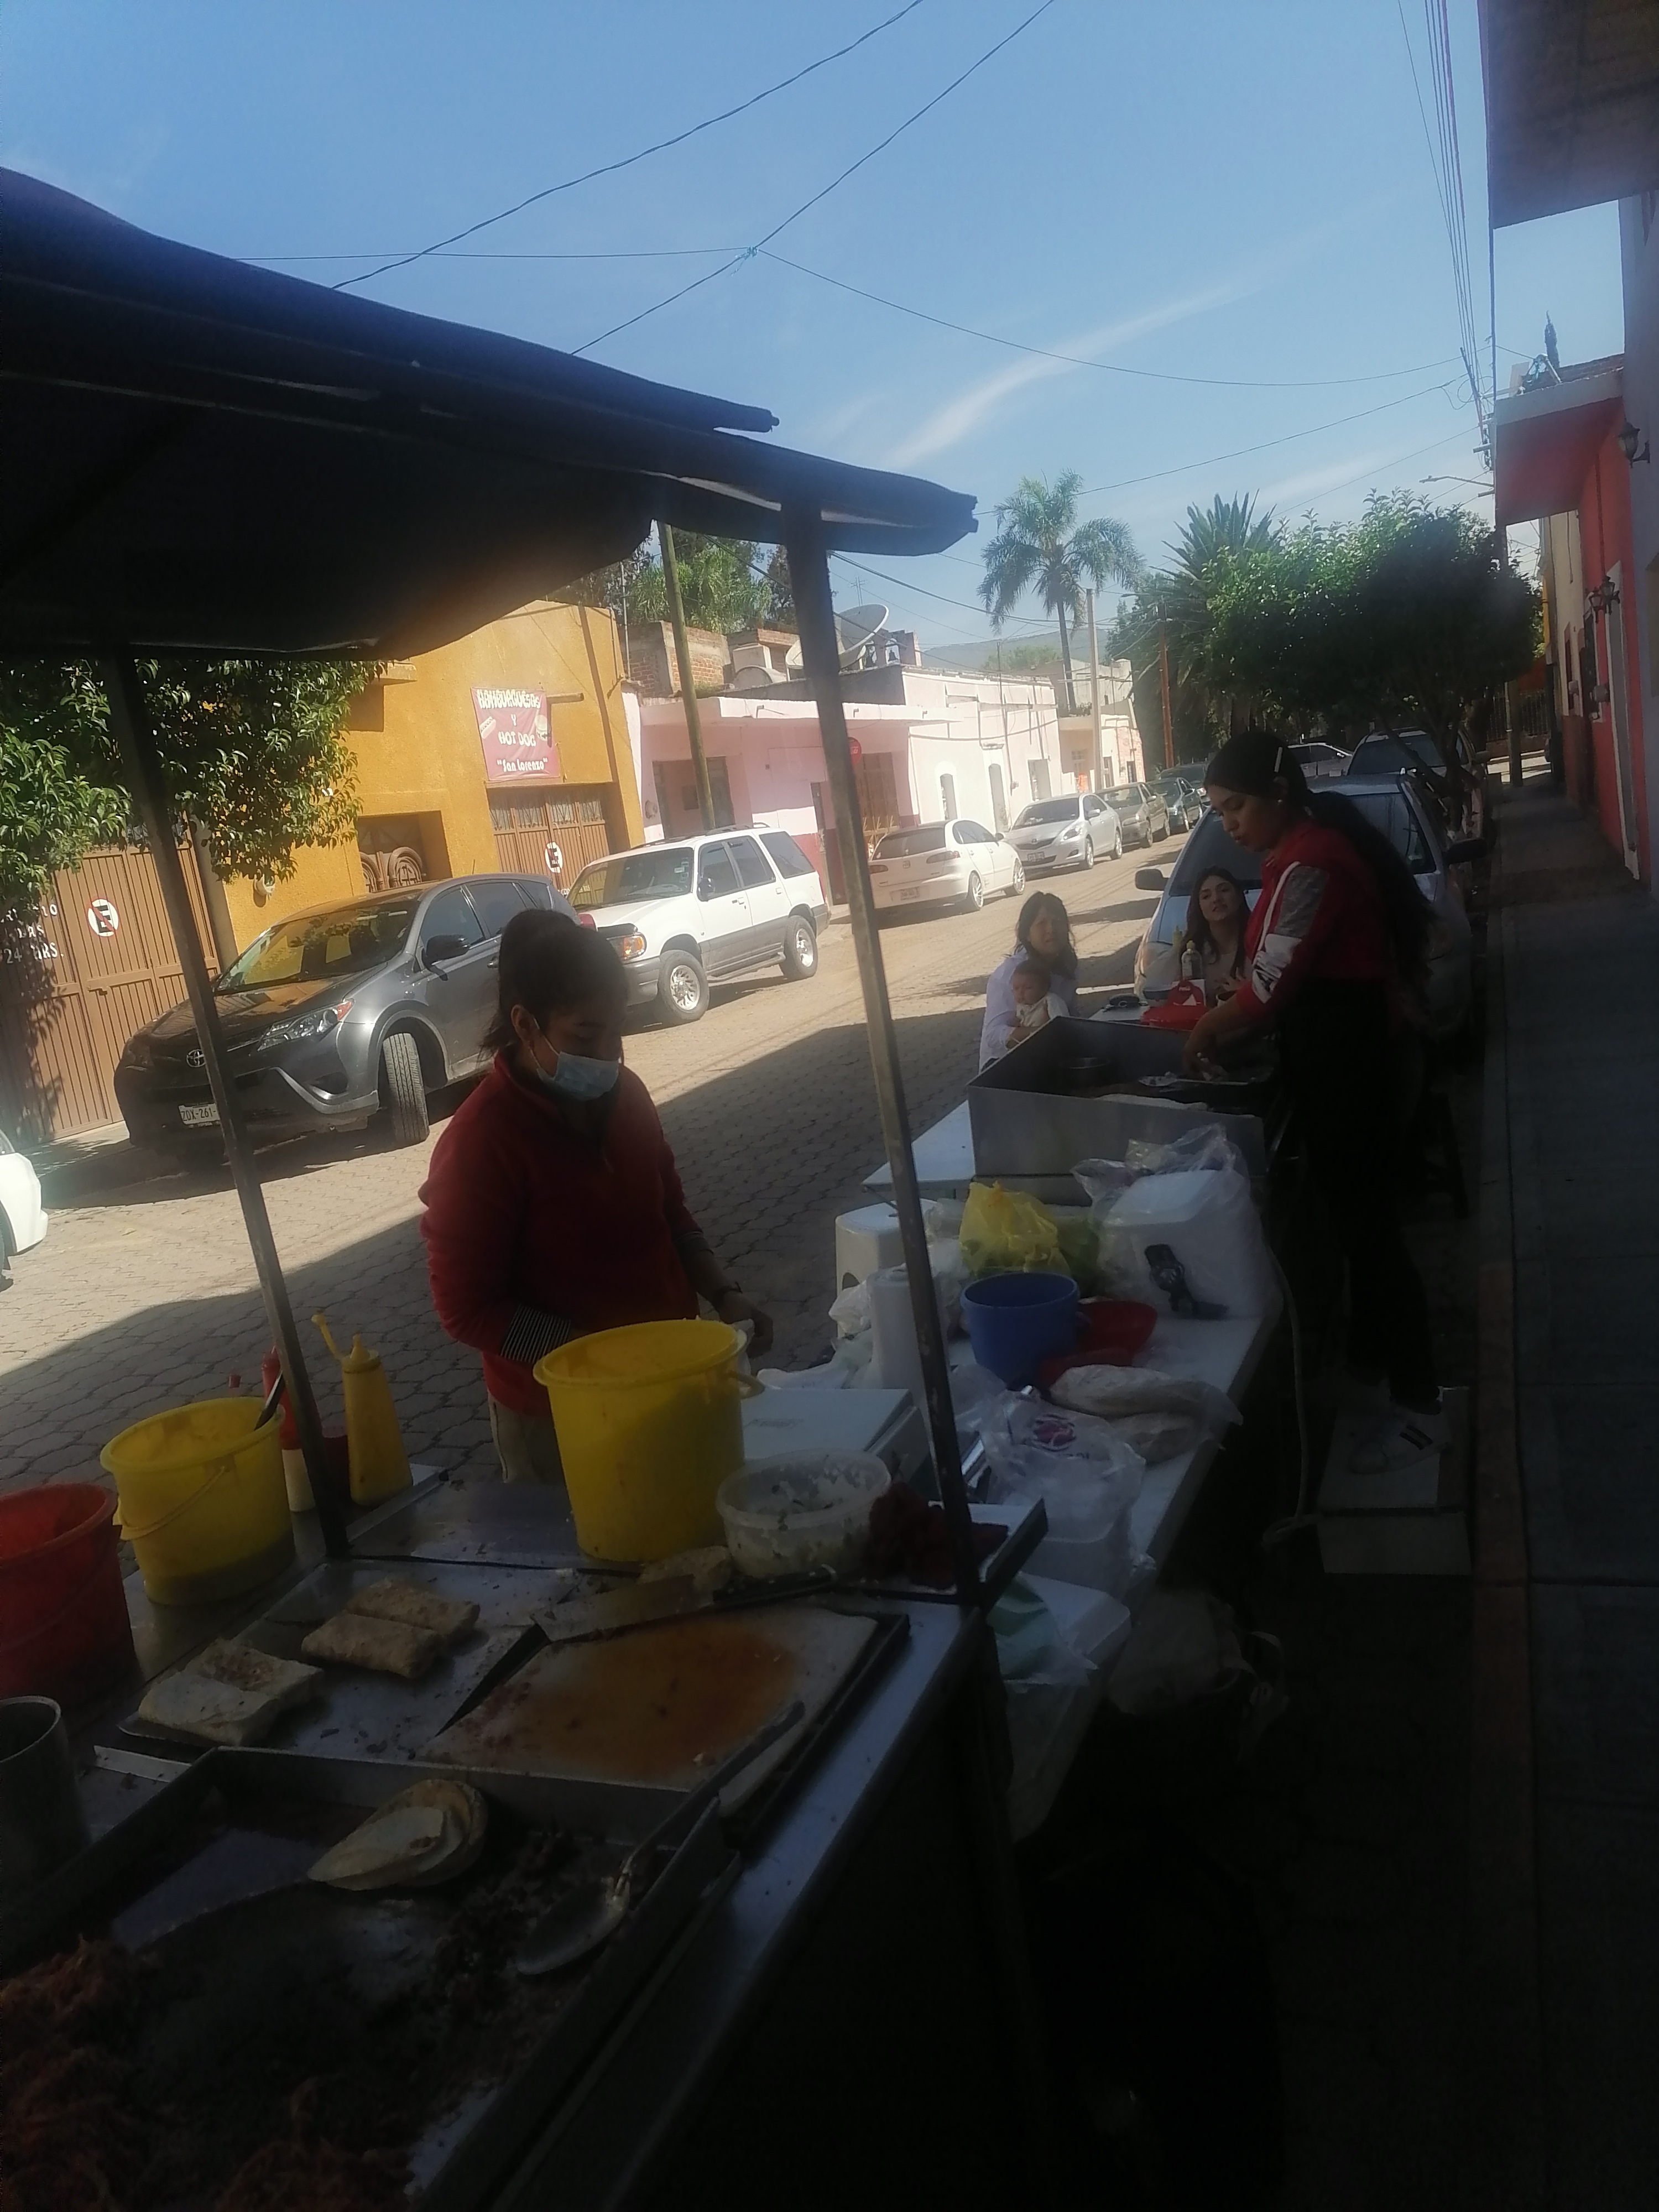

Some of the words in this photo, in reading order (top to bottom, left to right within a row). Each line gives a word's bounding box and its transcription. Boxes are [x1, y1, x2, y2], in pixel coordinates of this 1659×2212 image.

[510, 714, 517, 726] Y
[498, 731, 517, 745] HOT
[518, 733, 536, 747] DOG
[3, 947, 23, 964] 24
[180, 1107, 216, 1121] ZDX-261-
